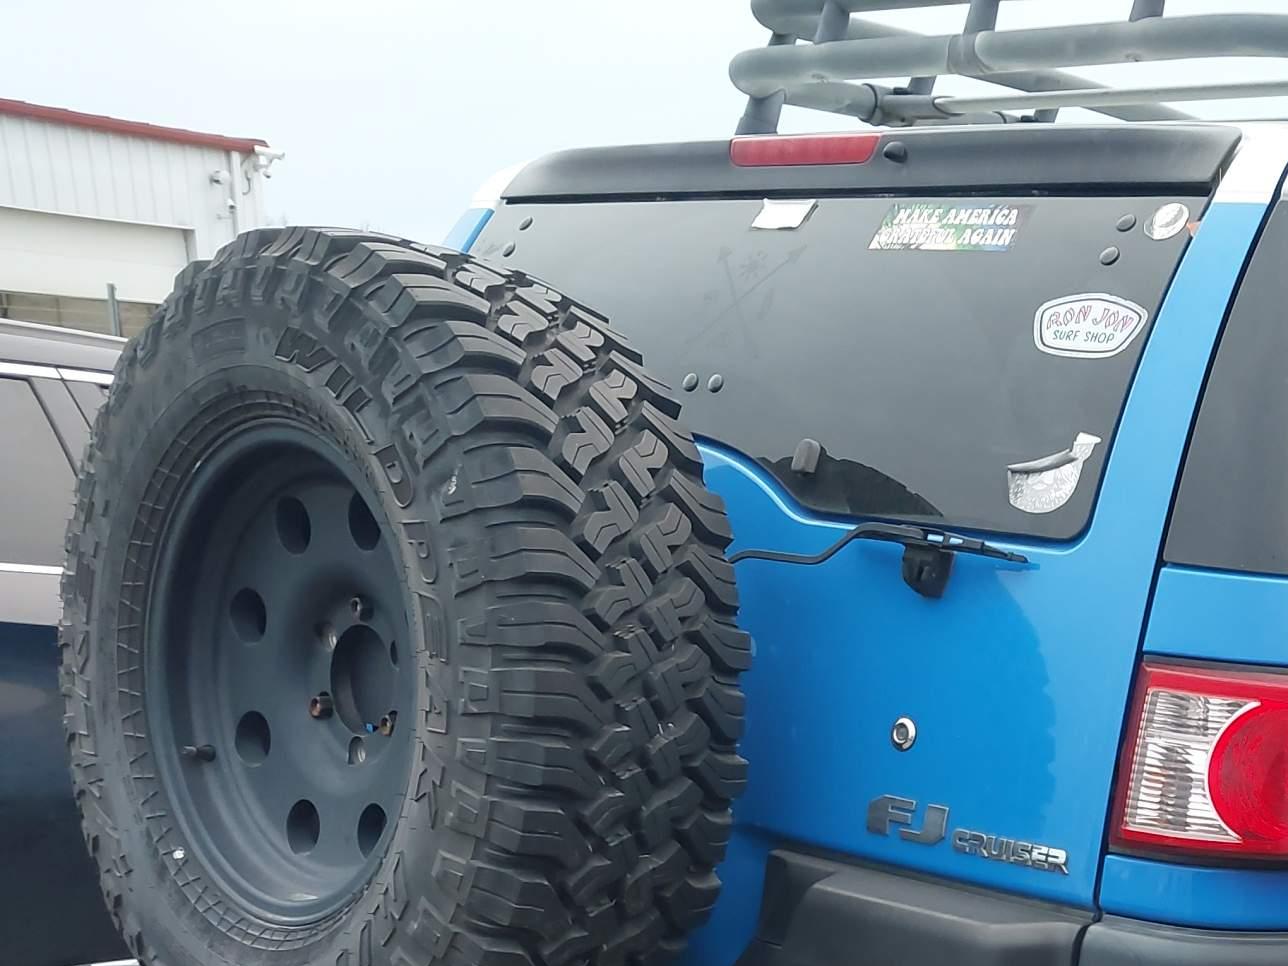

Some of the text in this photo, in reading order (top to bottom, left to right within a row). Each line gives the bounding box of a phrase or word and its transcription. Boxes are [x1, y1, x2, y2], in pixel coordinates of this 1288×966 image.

[893, 208, 1019, 226] MAKE AMERICA
[878, 227, 1017, 246] GRATEFUL AGAIN
[1046, 304, 1135, 333] RON JON
[1052, 329, 1115, 344] SURF SHOP
[867, 794, 1070, 876] FJ CRUISER
